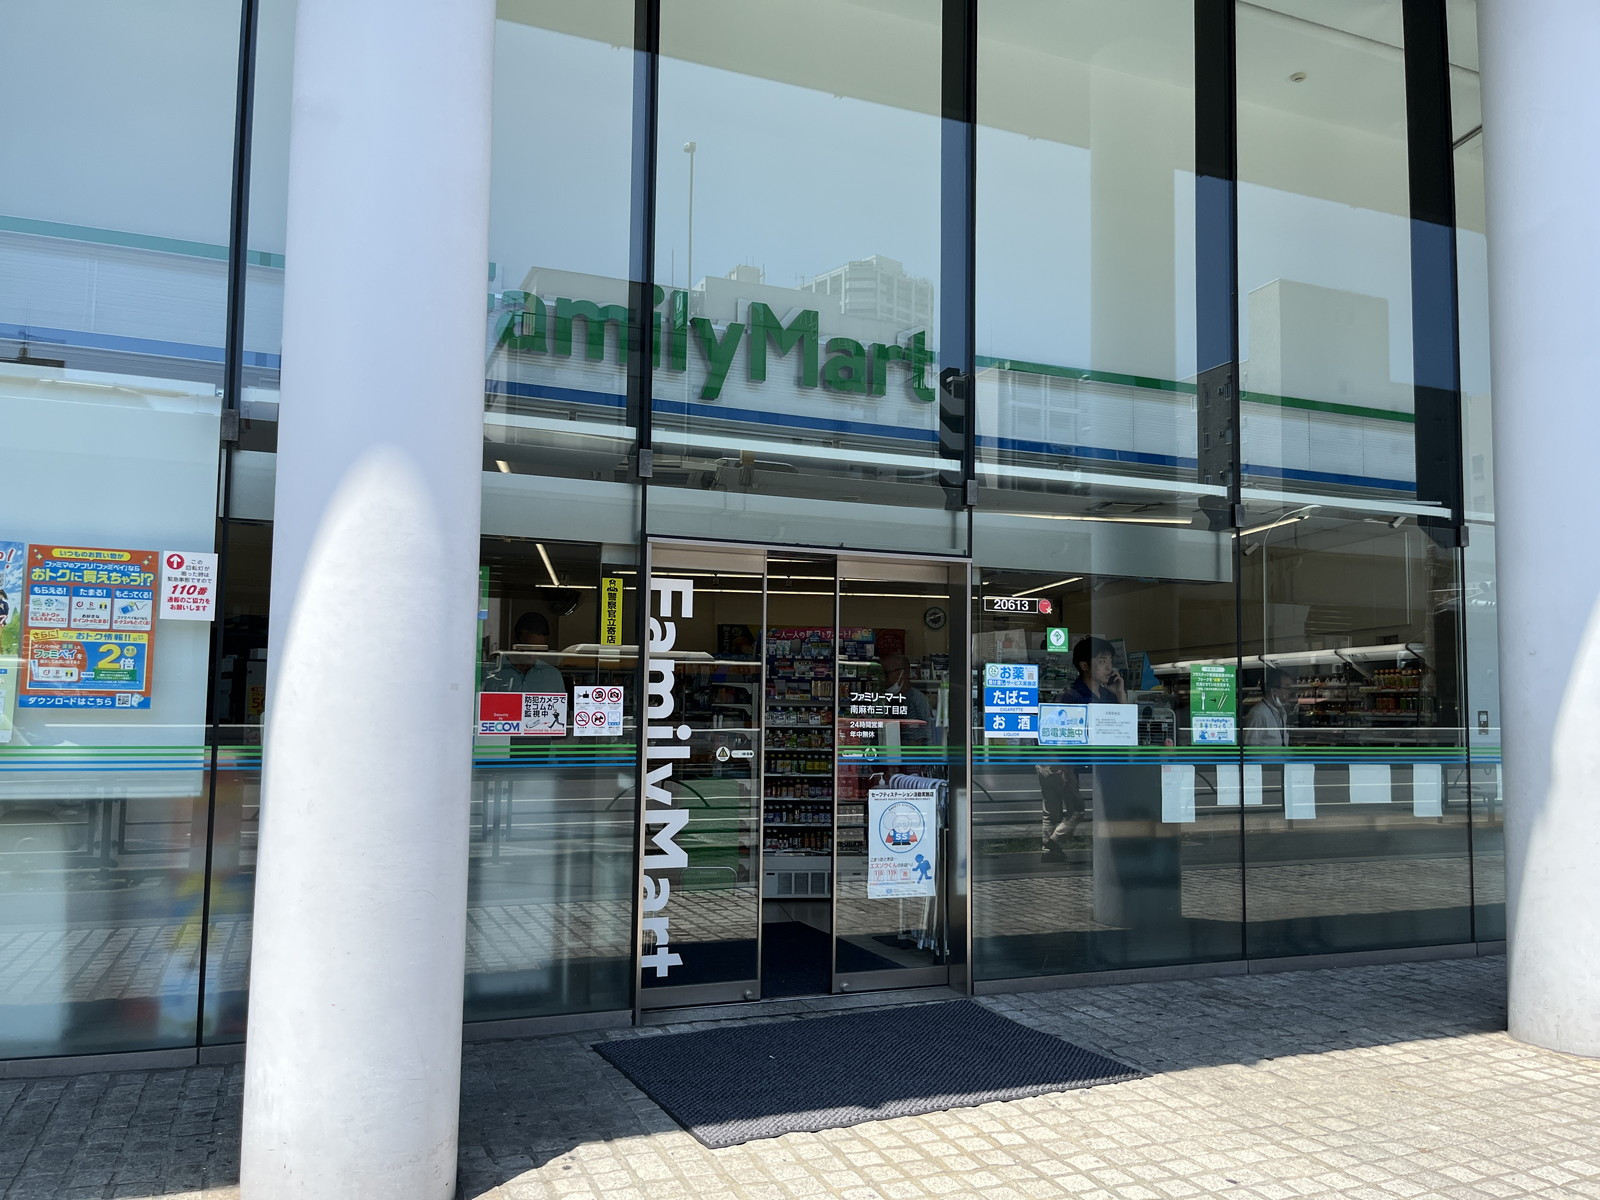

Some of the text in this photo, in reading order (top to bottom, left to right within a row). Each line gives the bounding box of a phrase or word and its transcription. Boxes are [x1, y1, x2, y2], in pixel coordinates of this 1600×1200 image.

[487, 262, 937, 403] amilyMart
[59, 549, 124, 559] いつものお買い物が
[33, 586, 67, 595] もらえる!
[79, 588, 107, 596] たまる!
[171, 584, 208, 595] 110番
[115, 591, 152, 599] もどってくる!
[993, 599, 1029, 610] 20613
[607, 592, 617, 643] 警察官立寄店
[1000, 666, 1025, 680] お薬
[28, 697, 112, 706] ダウンロードはこちら
[524, 696, 567, 704] 防犯カメラで
[850, 692, 907, 703] ファミリーマート
[992, 690, 1030, 704] たばこ
[524, 703, 554, 711] セコムが
[850, 705, 908, 715] 南麻布三丁目店
[524, 710, 549, 718] 監視中
[481, 722, 520, 732] SECOM
[1041, 727, 1084, 738] 節電実施中
